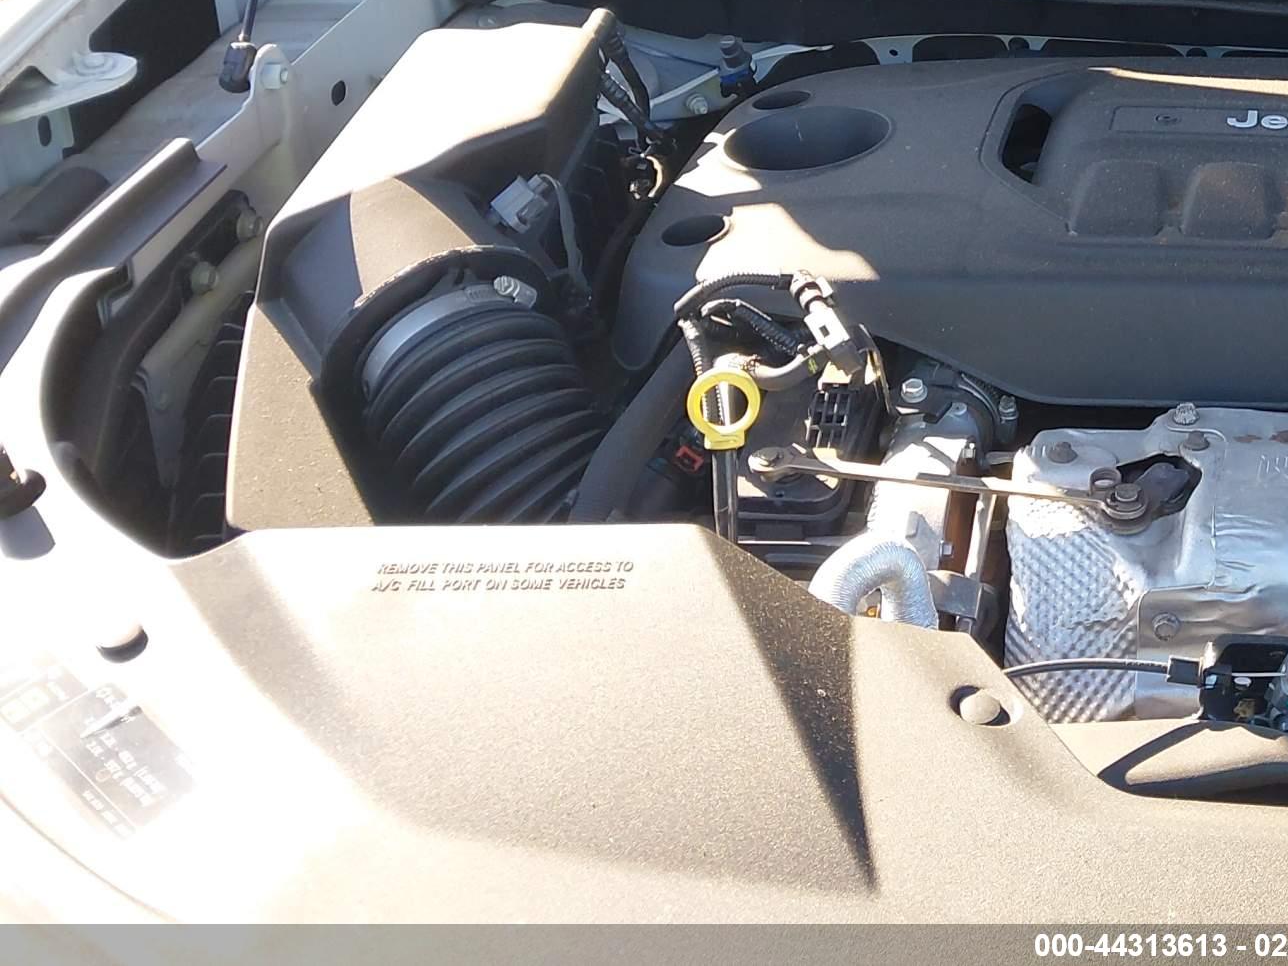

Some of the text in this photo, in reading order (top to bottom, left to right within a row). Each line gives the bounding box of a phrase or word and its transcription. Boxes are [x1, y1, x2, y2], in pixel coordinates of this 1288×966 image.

[377, 560, 634, 575] REMOVE THIS PANEL FOR ACCESS TO
[407, 579, 436, 591] FILL
[442, 579, 482, 591] PORT
[486, 579, 508, 591] ON
[511, 578, 553, 590] SOME
[559, 577, 626, 590] VEHICLES
